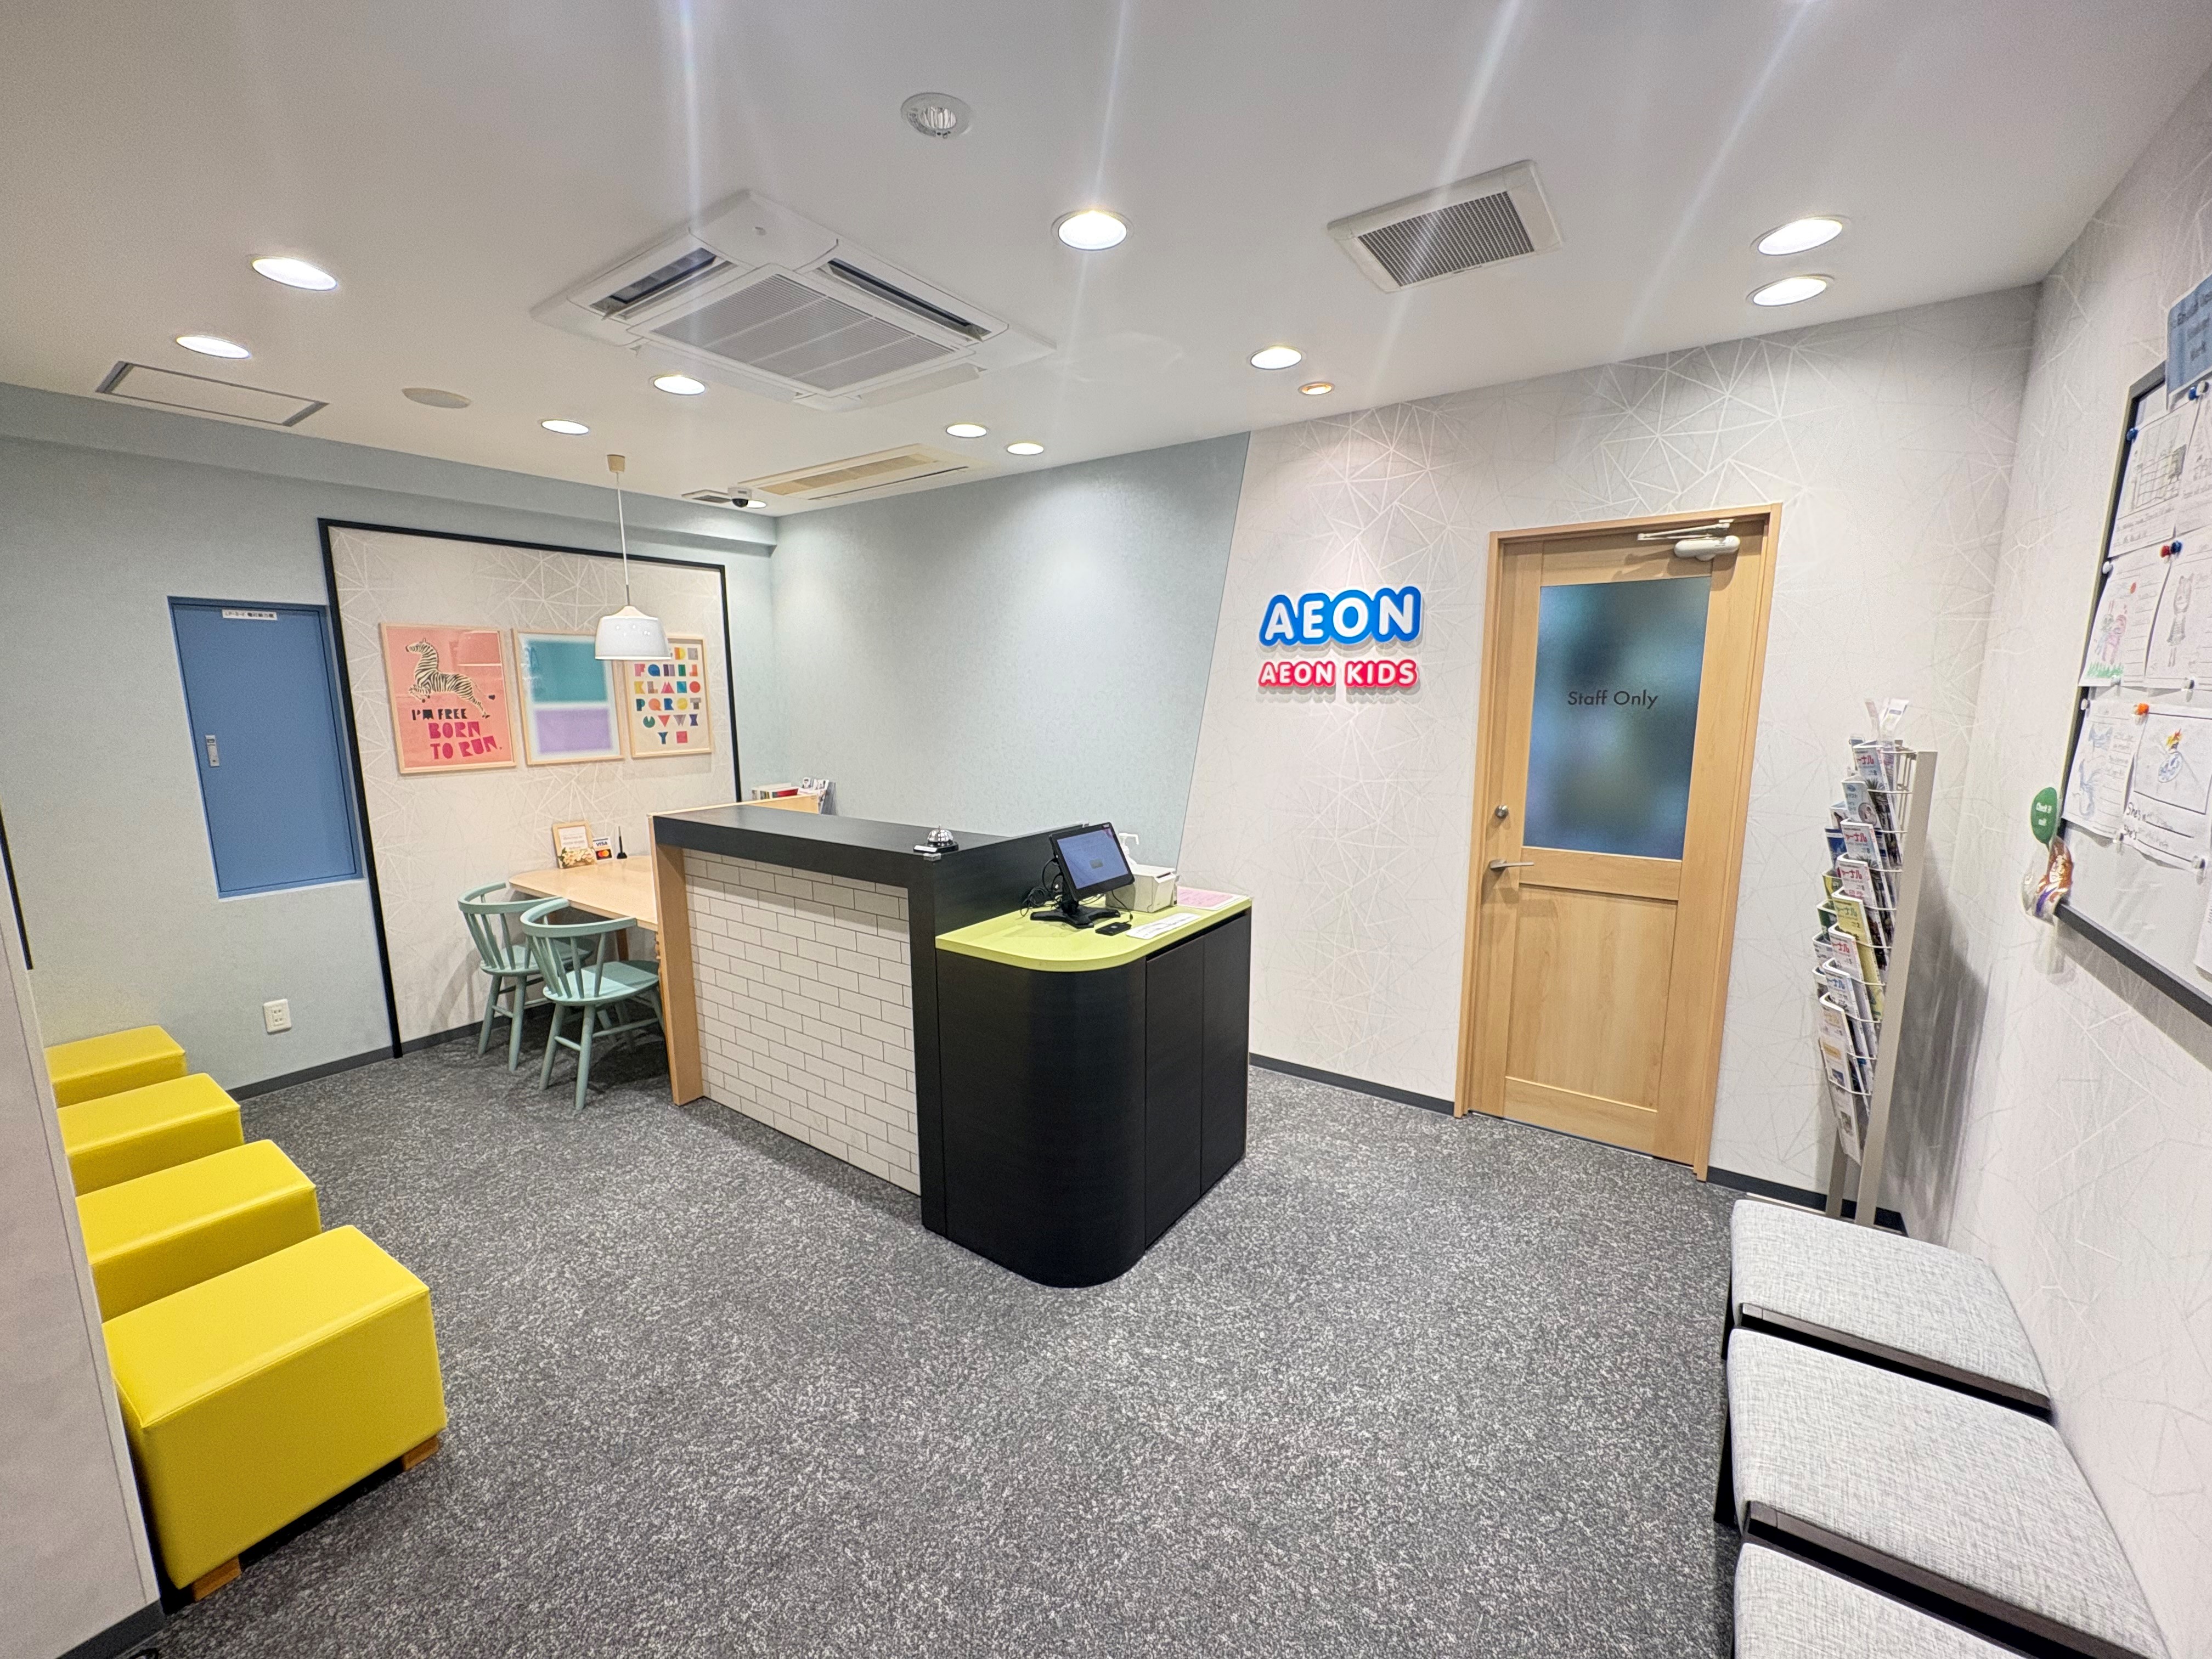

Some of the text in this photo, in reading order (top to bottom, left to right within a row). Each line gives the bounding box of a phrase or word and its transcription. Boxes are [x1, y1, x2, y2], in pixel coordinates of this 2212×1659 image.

[1262, 590, 1419, 644] AEON
[1259, 659, 1418, 687] AEON KIDS
[1567, 690, 1658, 710] Staff Only
[412, 708, 467, 720] I'M FREE
[428, 721, 481, 739] BORN
[430, 735, 503, 759] TO RUN.
